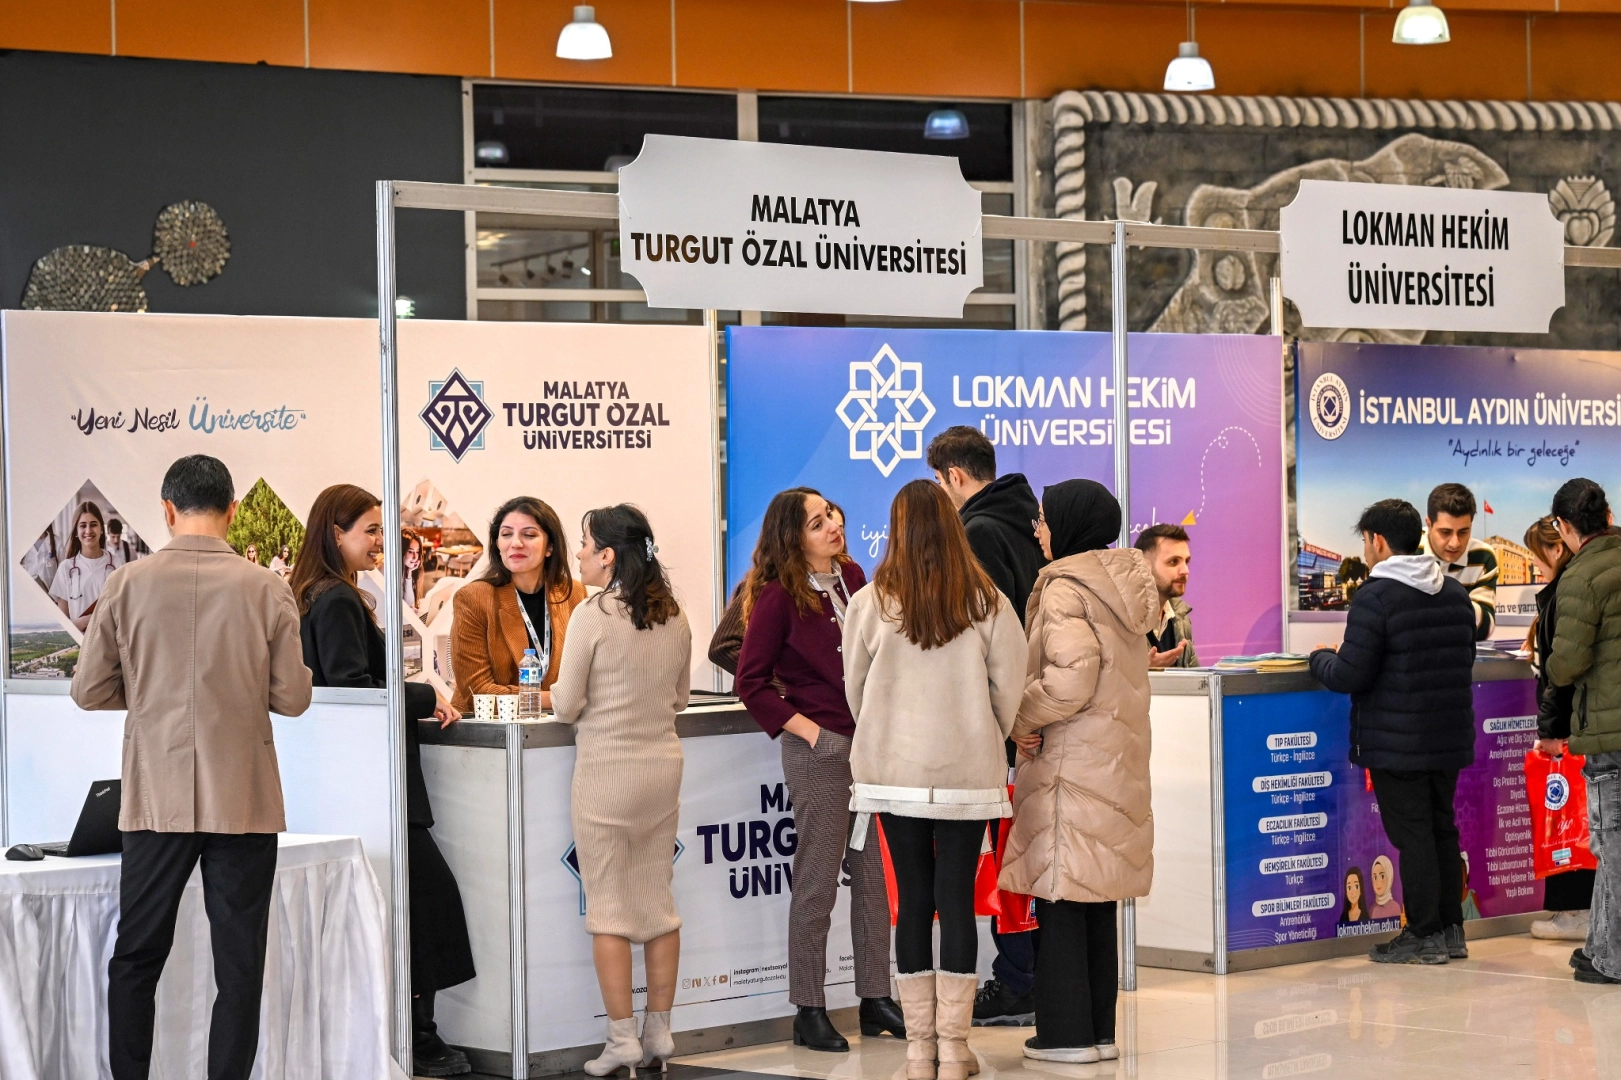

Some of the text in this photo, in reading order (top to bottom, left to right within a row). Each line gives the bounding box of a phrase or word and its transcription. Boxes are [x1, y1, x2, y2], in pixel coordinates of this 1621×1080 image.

[751, 195, 860, 227] MALATYA
[1342, 208, 1509, 250] LOKMAN HEKİM
[631, 230, 966, 275] TURGUT ÖZAL ÜNİVERSİTESİ
[1348, 262, 1494, 307] ÜNİVERSİTESİ
[544, 381, 630, 399] MALATYA
[953, 375, 1091, 408] LOKMAN
[502, 402, 670, 426] TURGUT ÖZAL
[1360, 389, 1463, 424] İSTANBUL
[1468, 398, 1528, 425] AYDIN
[1534, 392, 1621, 426] ÜNİVERSİ
[128, 407, 180, 433] Nesil
[980, 414, 1171, 446] ÜNİVERSİESİ
[523, 430, 651, 450] ÜNİVERSİTESİ
[1508, 441, 1525, 456] bir
[1507, 604, 1516, 612] ve
[1490, 717, 1535, 731] SAĞLIK HİZMETLERİ
[1275, 734, 1311, 747] TIP FAKÜLTESİ
[1271, 752, 1289, 763] Türkçe
[1293, 750, 1315, 763] İngilizce
[1508, 763, 1525, 771] Aneste
[1261, 773, 1325, 791] DİŞ HEKİMLİĞİ FAKÜLTESİ
[1271, 794, 1289, 804] Türkçe
[1294, 791, 1316, 804] İngilizce
[1266, 814, 1320, 830] ECZACILIK FAKÜLTESİ
[697, 818, 798, 864] TURG
[1271, 835, 1289, 845] Türkçe
[1294, 832, 1316, 844] İngilizce
[1264, 855, 1323, 873] HEMŞİRELİK FAKÜLTESİ
[1285, 874, 1304, 885] Türkçe
[1261, 895, 1330, 914] SPOR BİLİMLERİ FAKÜLTESİ
[1280, 914, 1311, 927] Antrenörlük
[1275, 927, 1317, 944] Spor Yöneticiliği
